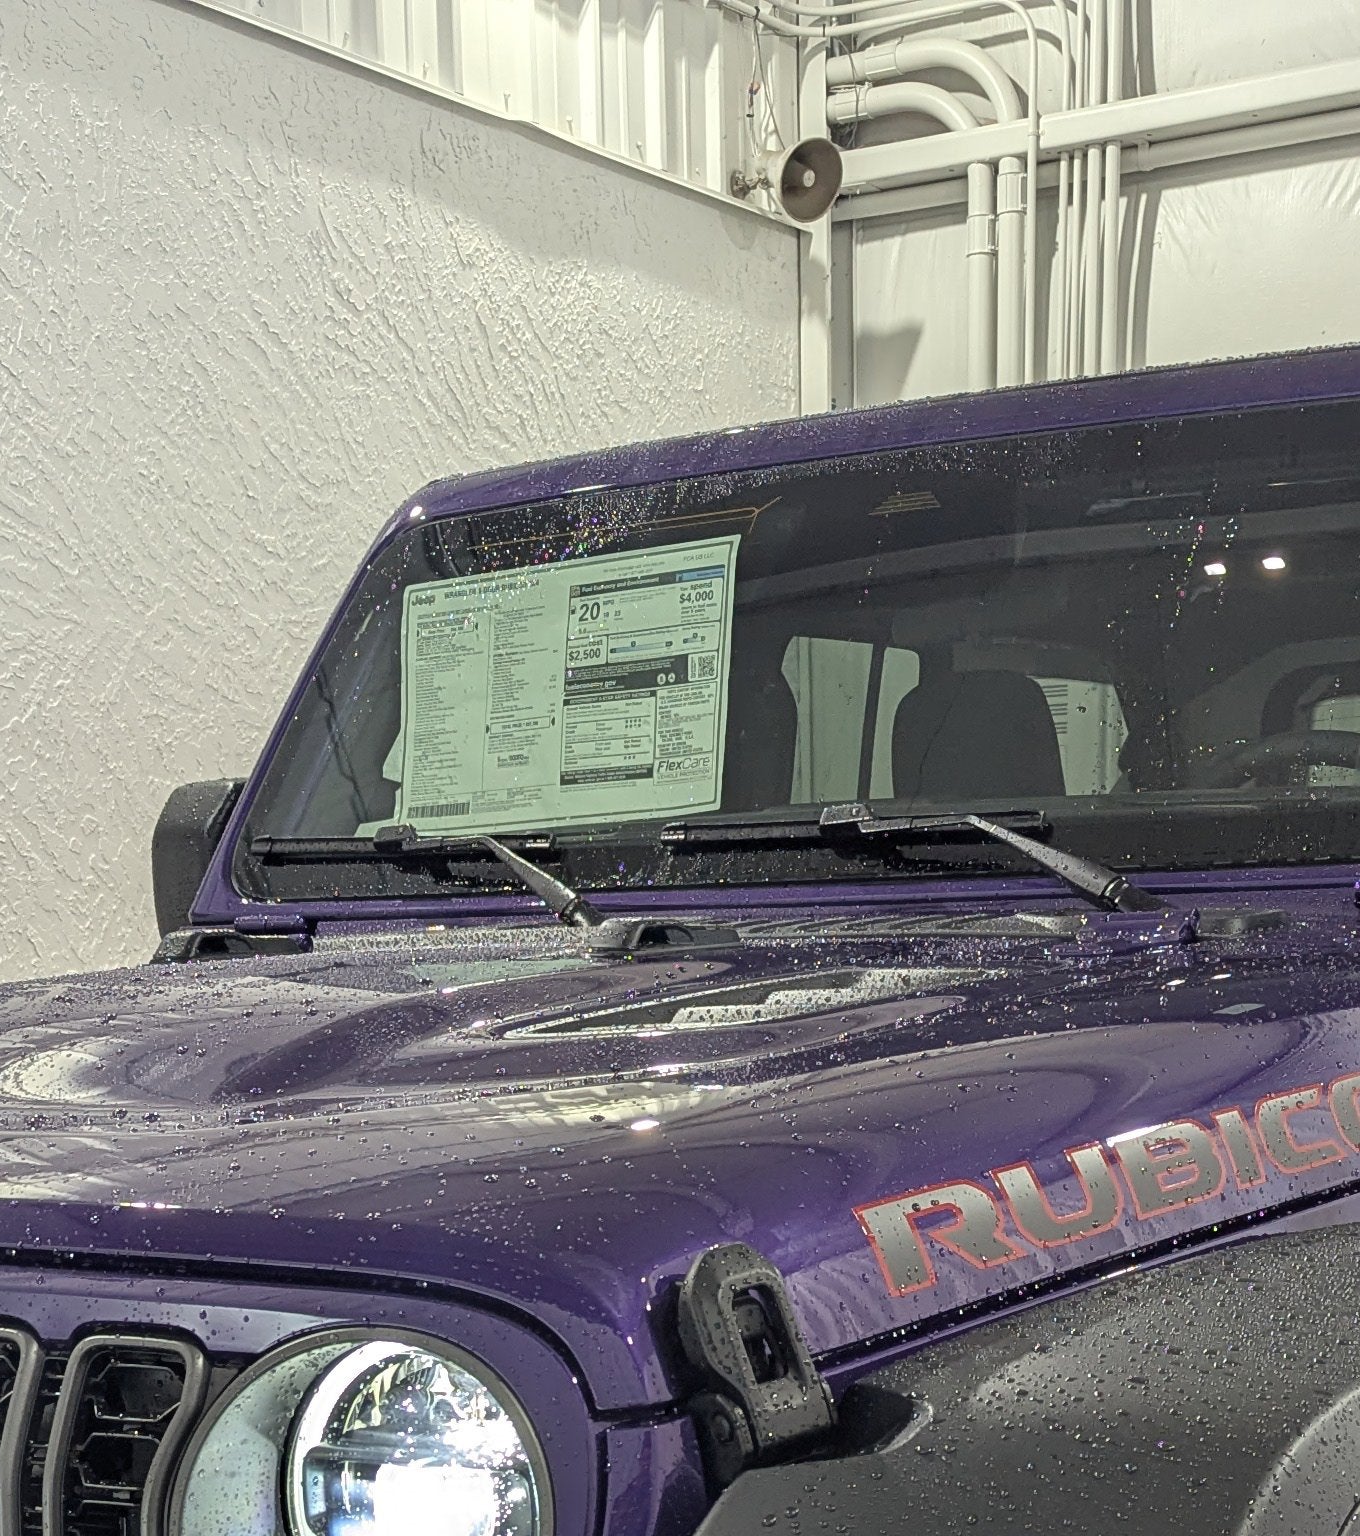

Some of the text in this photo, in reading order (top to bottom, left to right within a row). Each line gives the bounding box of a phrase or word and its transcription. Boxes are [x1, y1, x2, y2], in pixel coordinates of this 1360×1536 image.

[679, 590, 714, 605] $4,000
[578, 601, 601, 622] 20
[568, 648, 601, 662] $2,500
[656, 755, 710, 773] FlexCare
